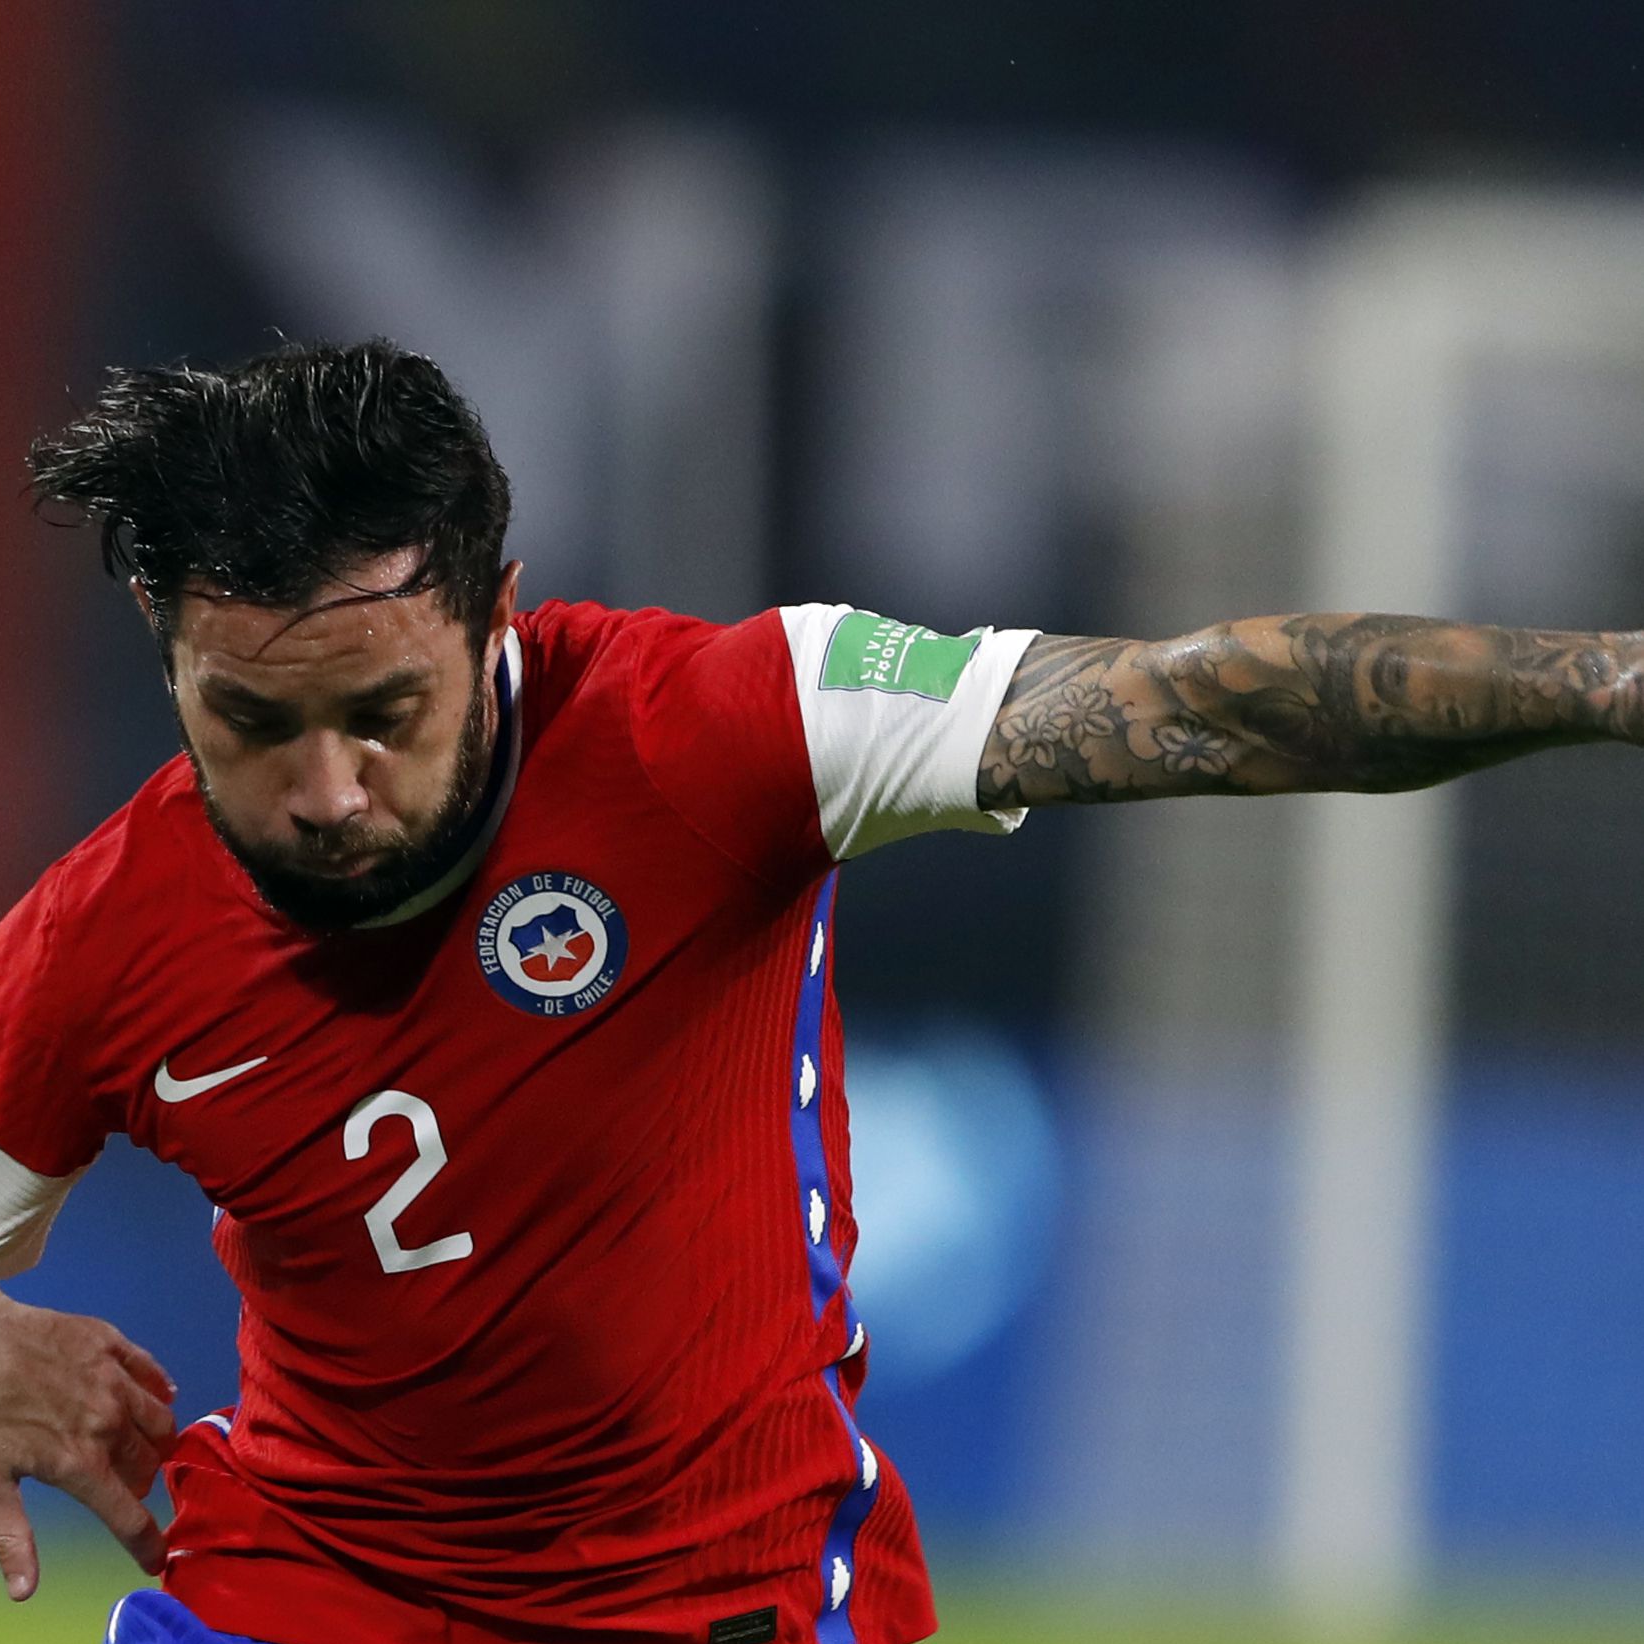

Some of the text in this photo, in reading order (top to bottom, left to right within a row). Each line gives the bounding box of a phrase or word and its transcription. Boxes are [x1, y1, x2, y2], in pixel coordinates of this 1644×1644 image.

[479, 873, 616, 975] FEDERACION DE FUTBOL
[574, 975, 613, 1010] CHILE
[343, 1089, 474, 1274] 2
